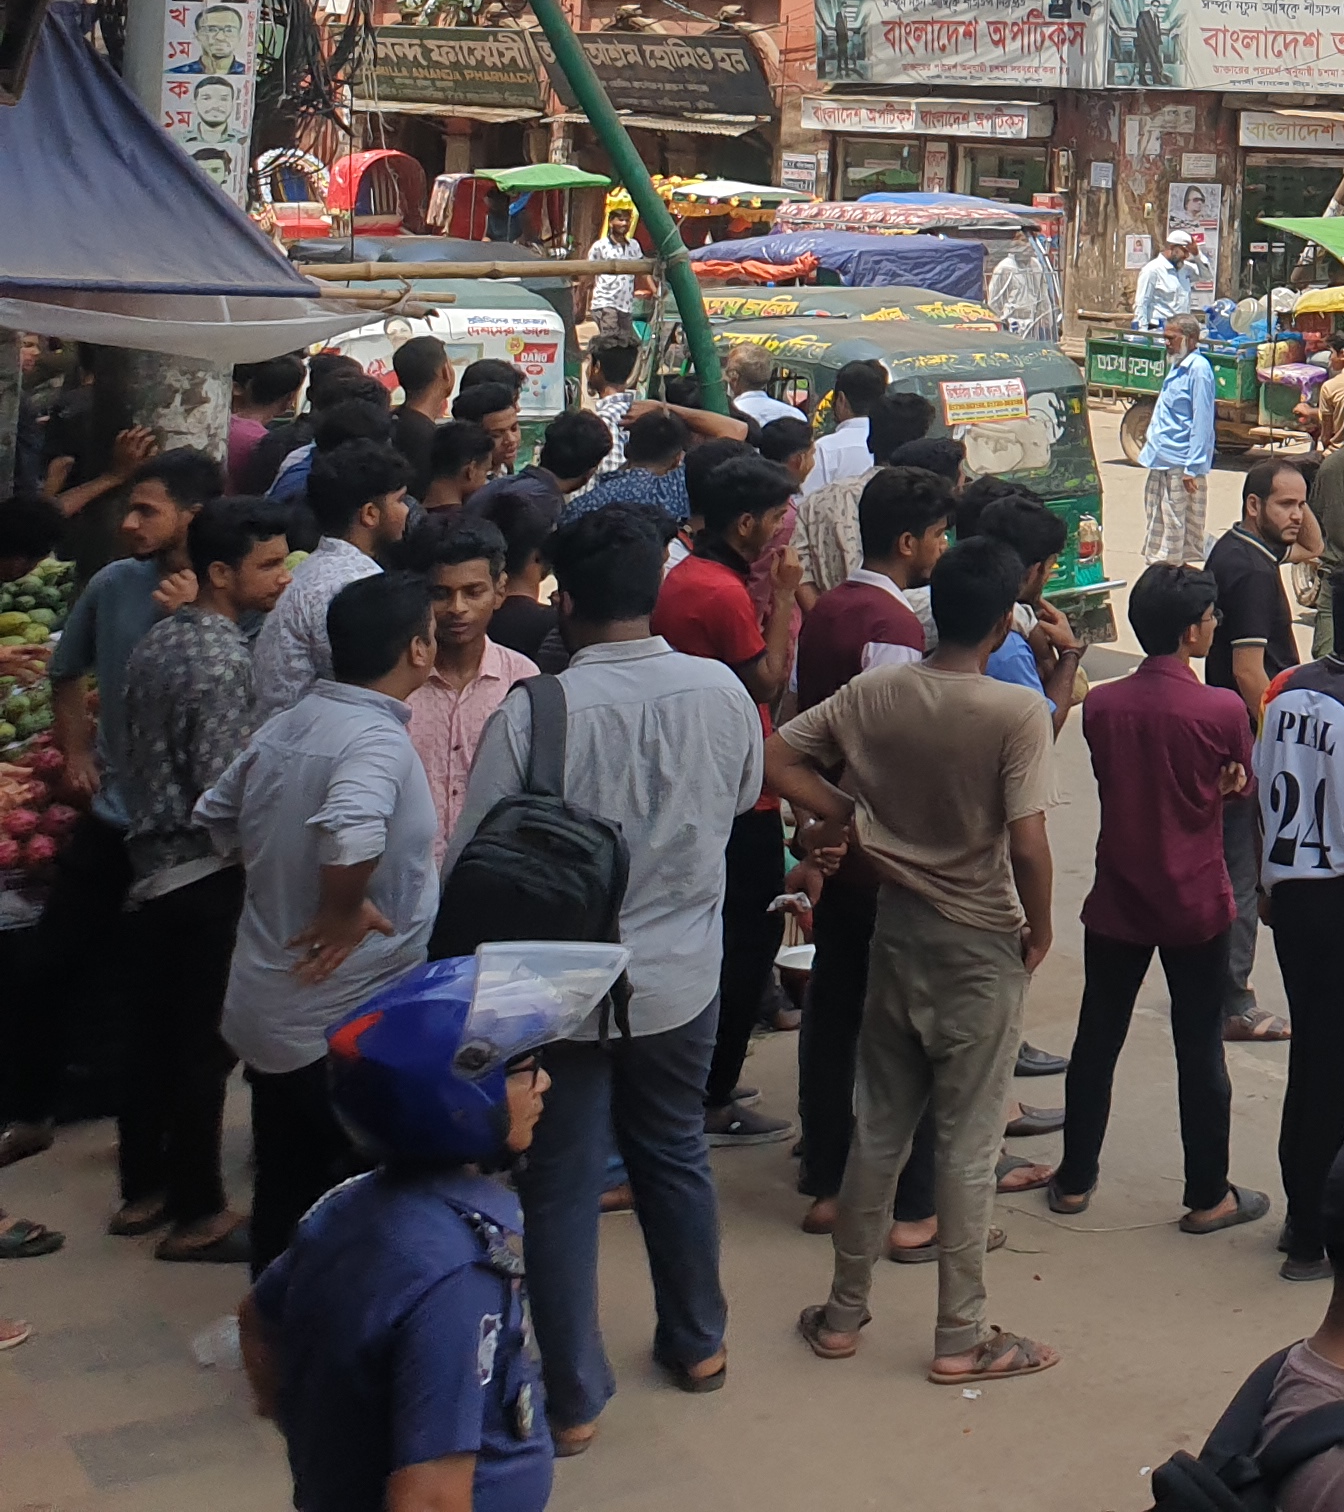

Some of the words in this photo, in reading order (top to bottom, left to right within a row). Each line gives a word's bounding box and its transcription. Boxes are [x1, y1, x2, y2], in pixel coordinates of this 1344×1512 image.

[881, 16, 979, 56] বাংলাদেশ
[1200, 24, 1322, 61] বাংলাদেশ
[463, 70, 535, 85] PHARMACY
[812, 105, 862, 127] বাংলাদেশ
[1246, 121, 1336, 144] বাংলাদেশ
[521, 352, 548, 363] DANO
[1268, 769, 1332, 869] 24
